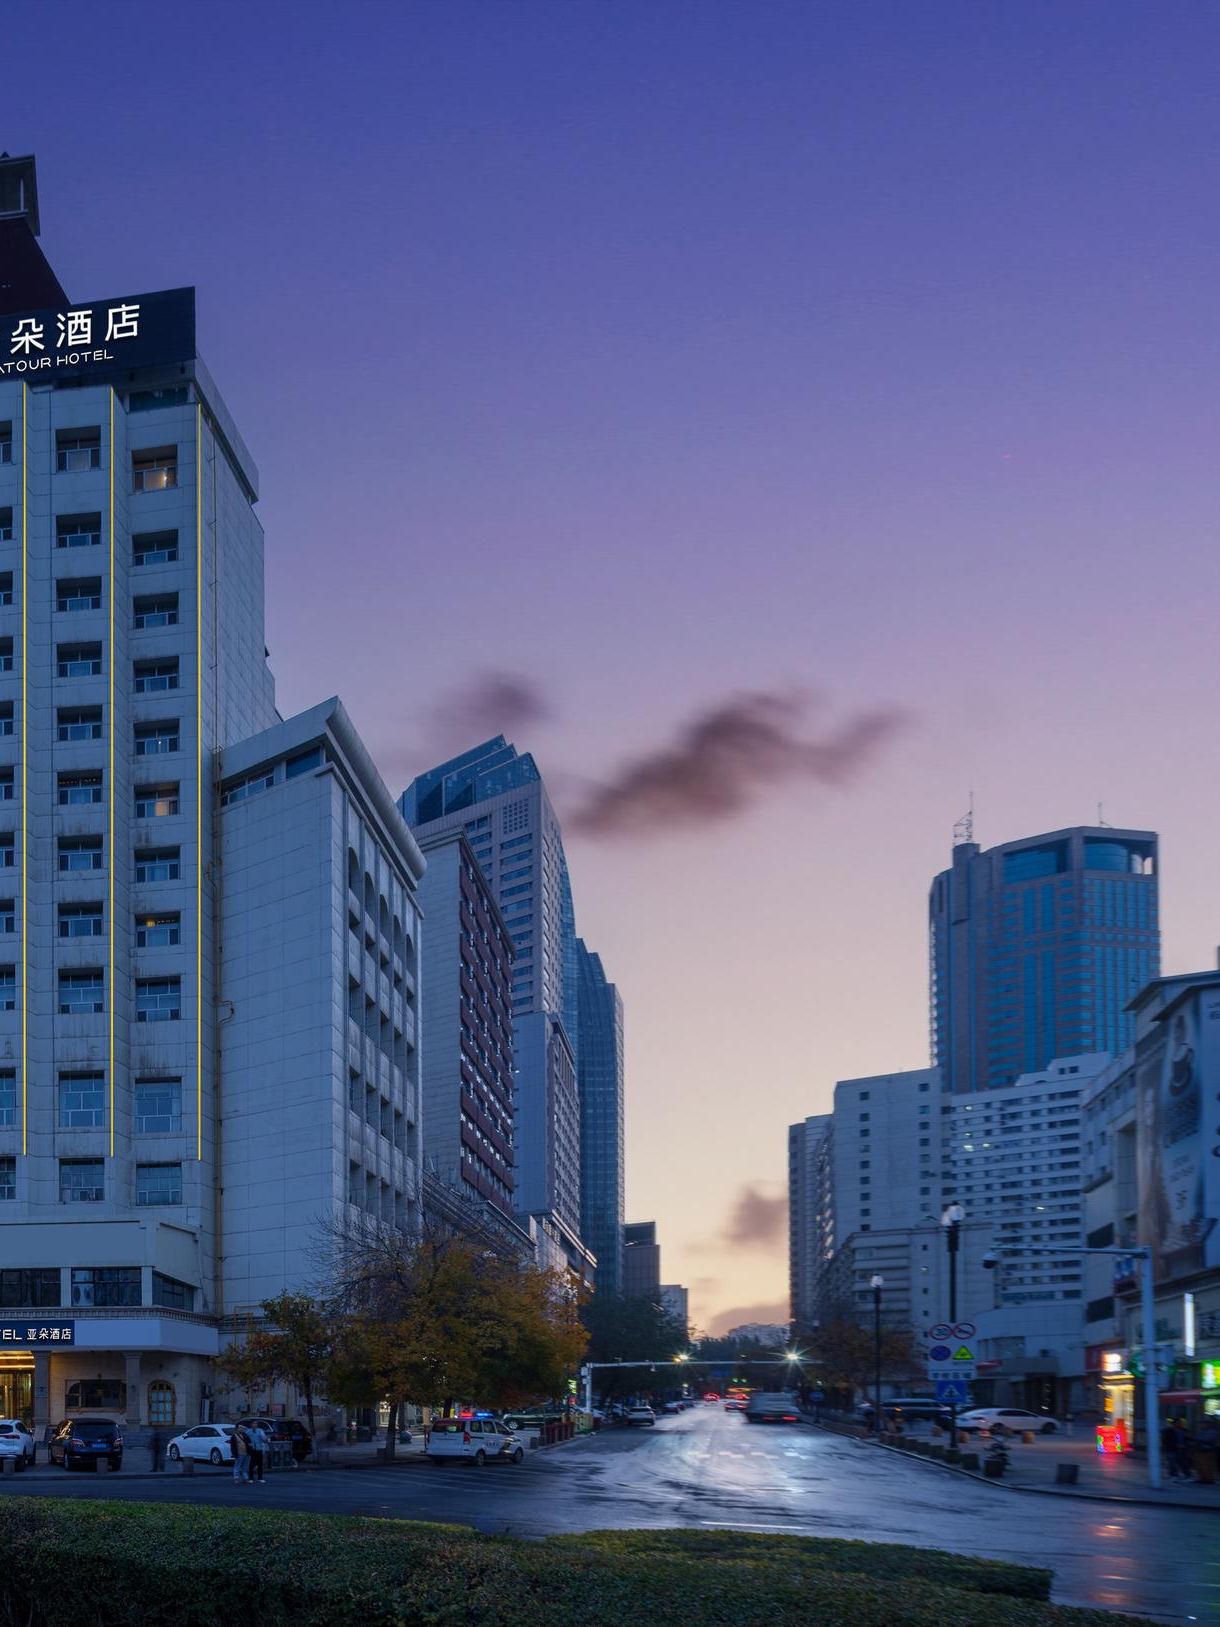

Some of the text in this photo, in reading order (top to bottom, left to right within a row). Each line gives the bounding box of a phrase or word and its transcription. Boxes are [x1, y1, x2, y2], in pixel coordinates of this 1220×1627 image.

[56, 349, 114, 366] HOTEL
[27, 1328, 72, 1340] 亚朵酒店
